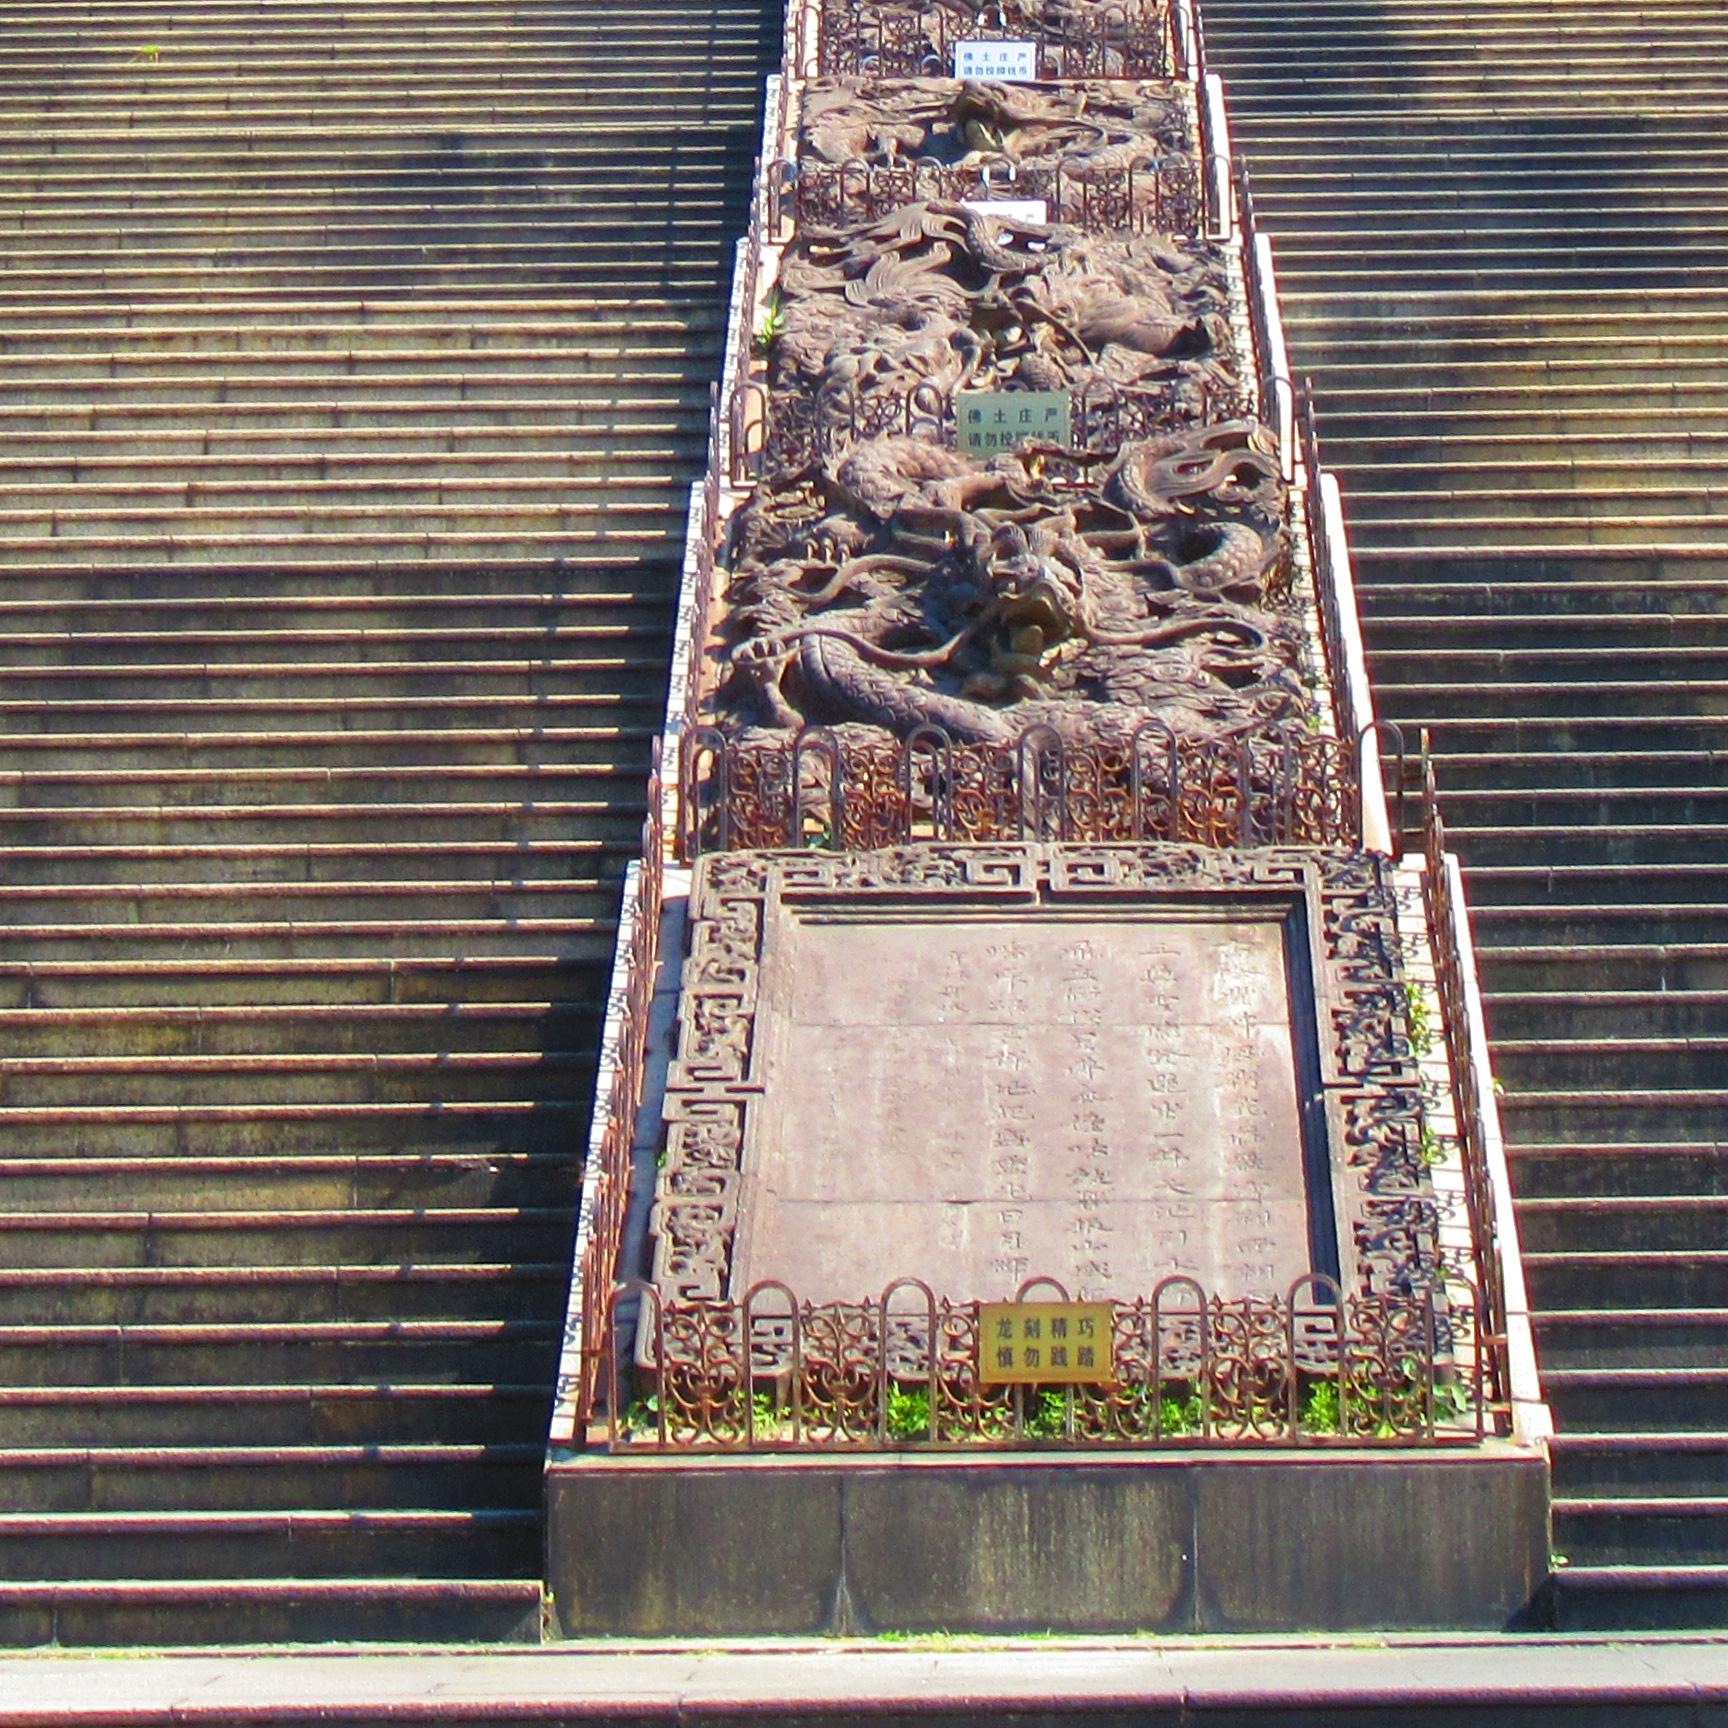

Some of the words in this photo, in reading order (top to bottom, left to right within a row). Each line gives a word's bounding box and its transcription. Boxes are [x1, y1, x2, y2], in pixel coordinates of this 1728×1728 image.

[997, 1317, 1095, 1339] 龙刻精巧
[997, 1346, 1095, 1368] 慎勿践踏
